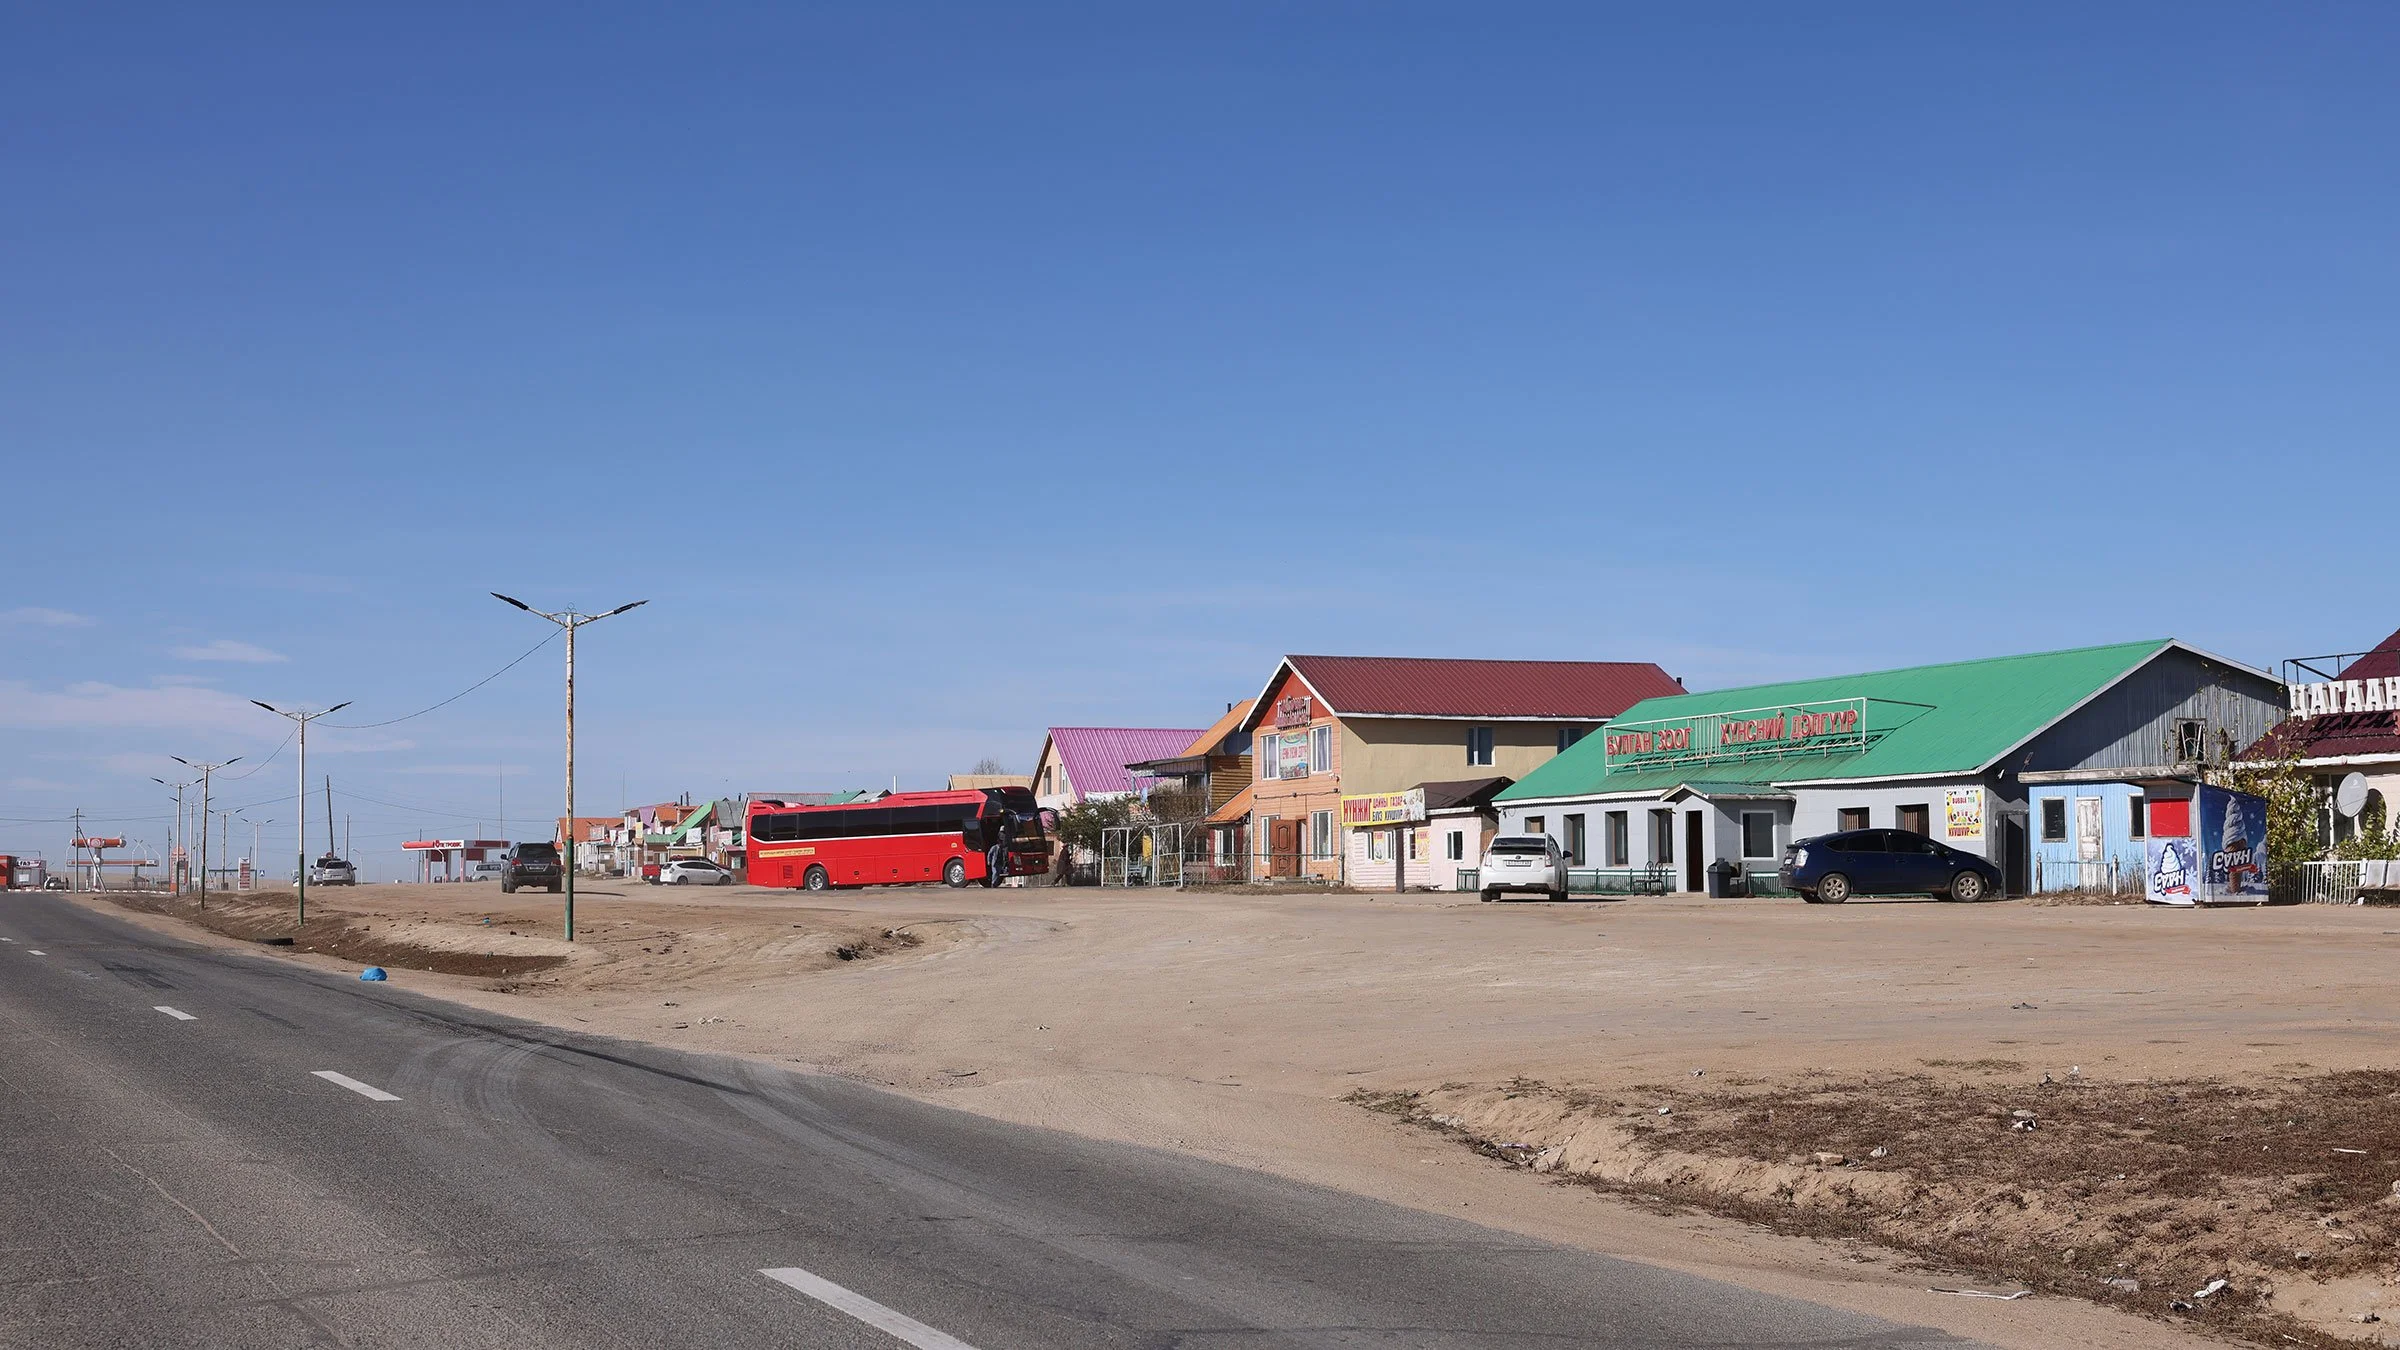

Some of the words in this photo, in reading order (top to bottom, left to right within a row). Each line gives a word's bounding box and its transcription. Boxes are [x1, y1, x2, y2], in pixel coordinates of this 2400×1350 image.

[2289, 677, 2400, 720] ЦАГААН
[1720, 712, 1785, 744] ХҮНСНИЙ
[1790, 709, 1858, 742] ДЭЛГҮҮР
[1607, 732, 1653, 755] БУЛГАН
[1657, 727, 1692, 750] ЗООГ
[1343, 798, 1372, 823] НҮНЖИГ
[1390, 796, 1403, 807] ГАЗАР
